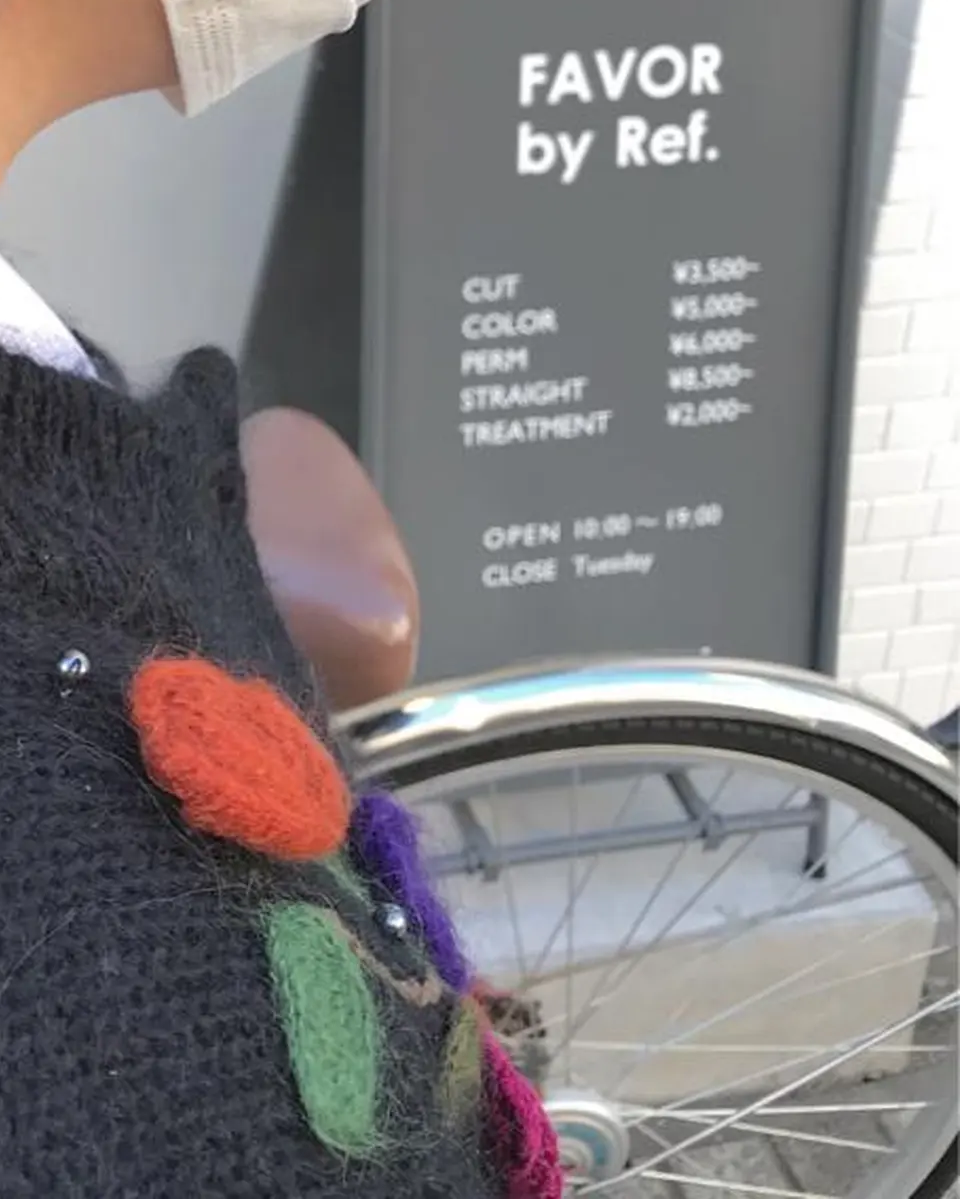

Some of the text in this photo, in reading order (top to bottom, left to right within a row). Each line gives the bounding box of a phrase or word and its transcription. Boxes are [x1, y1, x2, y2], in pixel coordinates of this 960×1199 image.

[519, 43, 723, 107] FAVOR
[517, 108, 720, 185] by Ref.
[462, 273, 522, 303] CUT
[461, 307, 559, 340] COLOR
[460, 347, 529, 377] PERM
[459, 376, 590, 413] STRAIGHT
[459, 410, 614, 448] TREATMENT
[482, 520, 562, 551] OPEN
[481, 550, 656, 588] CLOSE Tuesday
